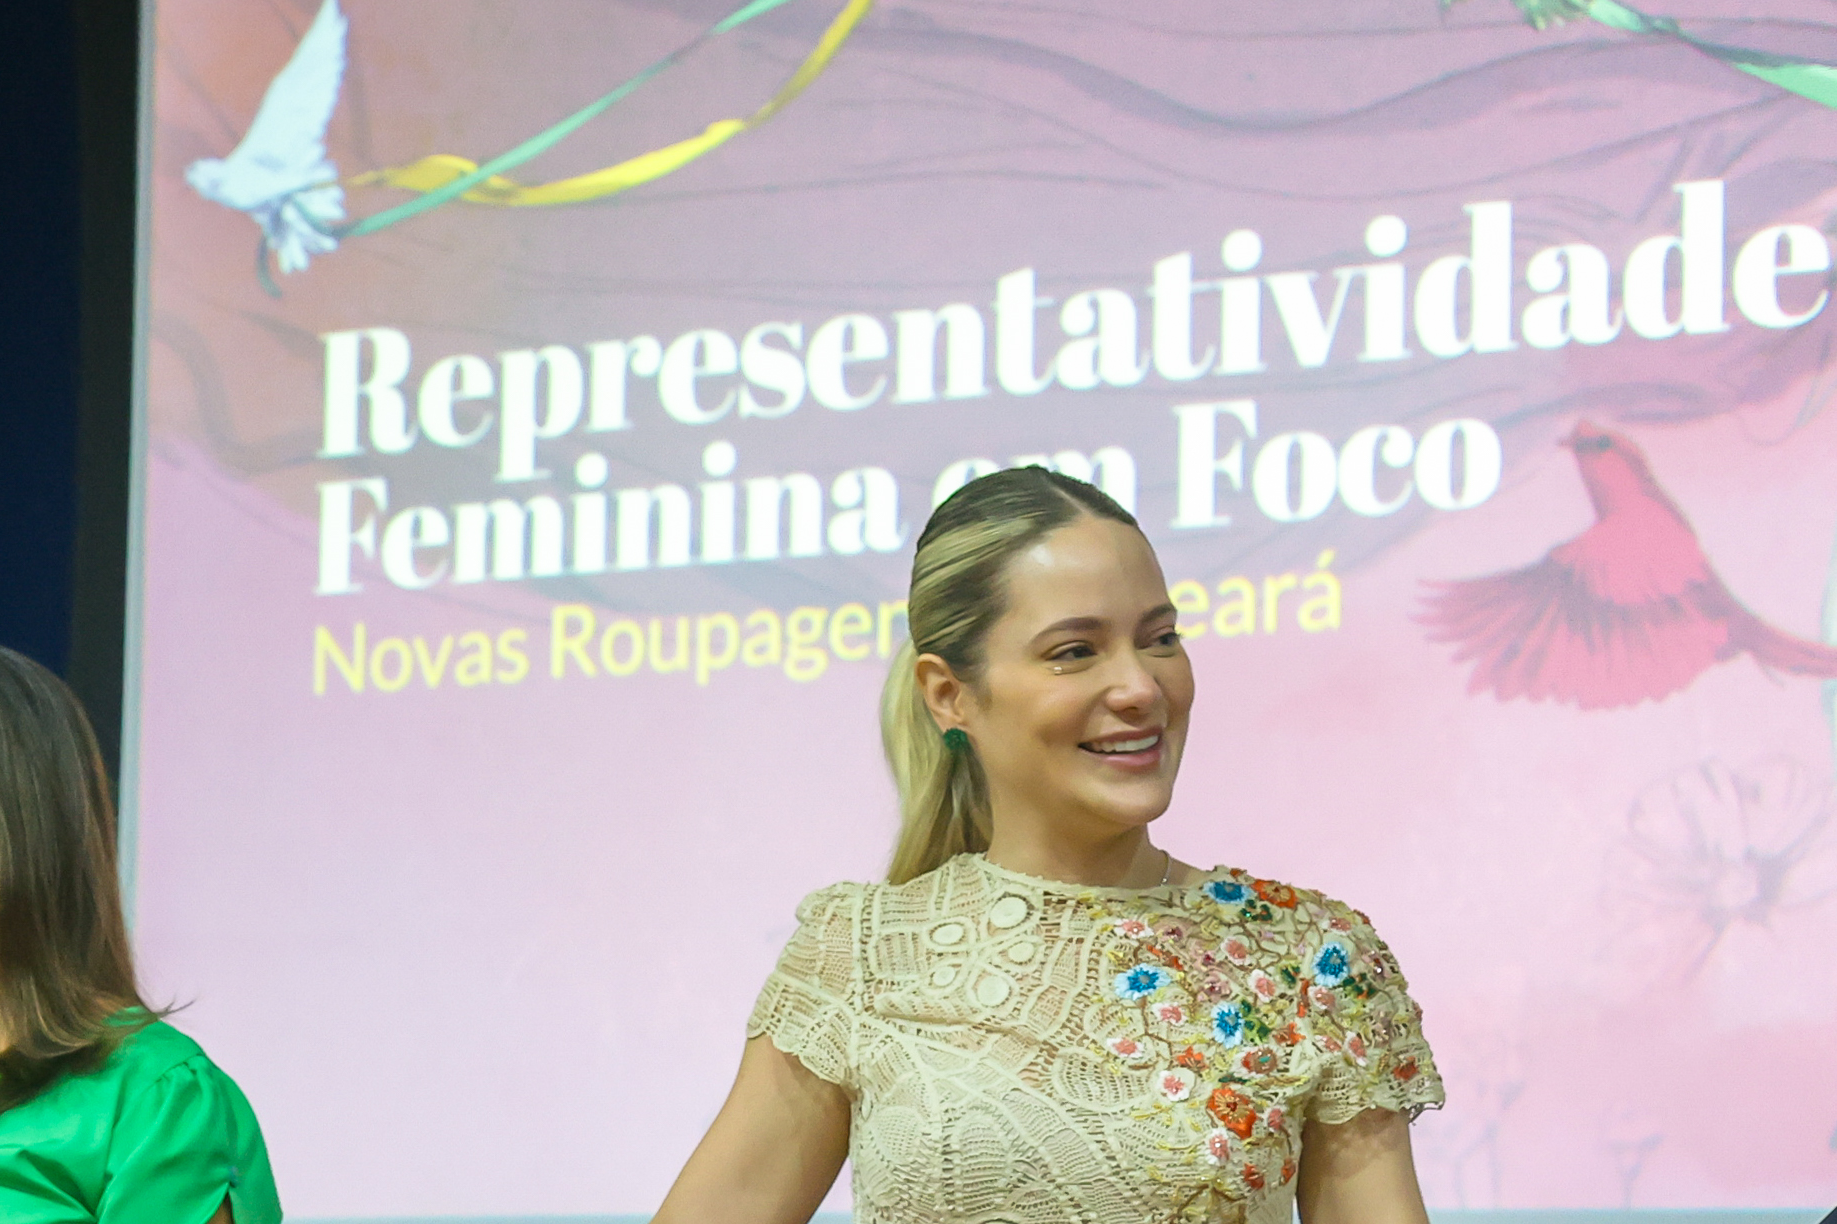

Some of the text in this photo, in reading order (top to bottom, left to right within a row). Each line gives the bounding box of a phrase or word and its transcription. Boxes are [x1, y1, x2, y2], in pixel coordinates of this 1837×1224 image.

[317, 180, 1831, 482] Representatividade
[314, 440, 907, 596] Feminina
[1169, 399, 1503, 529] Foco
[312, 623, 530, 696] Novas
[1167, 547, 1341, 639] eará
